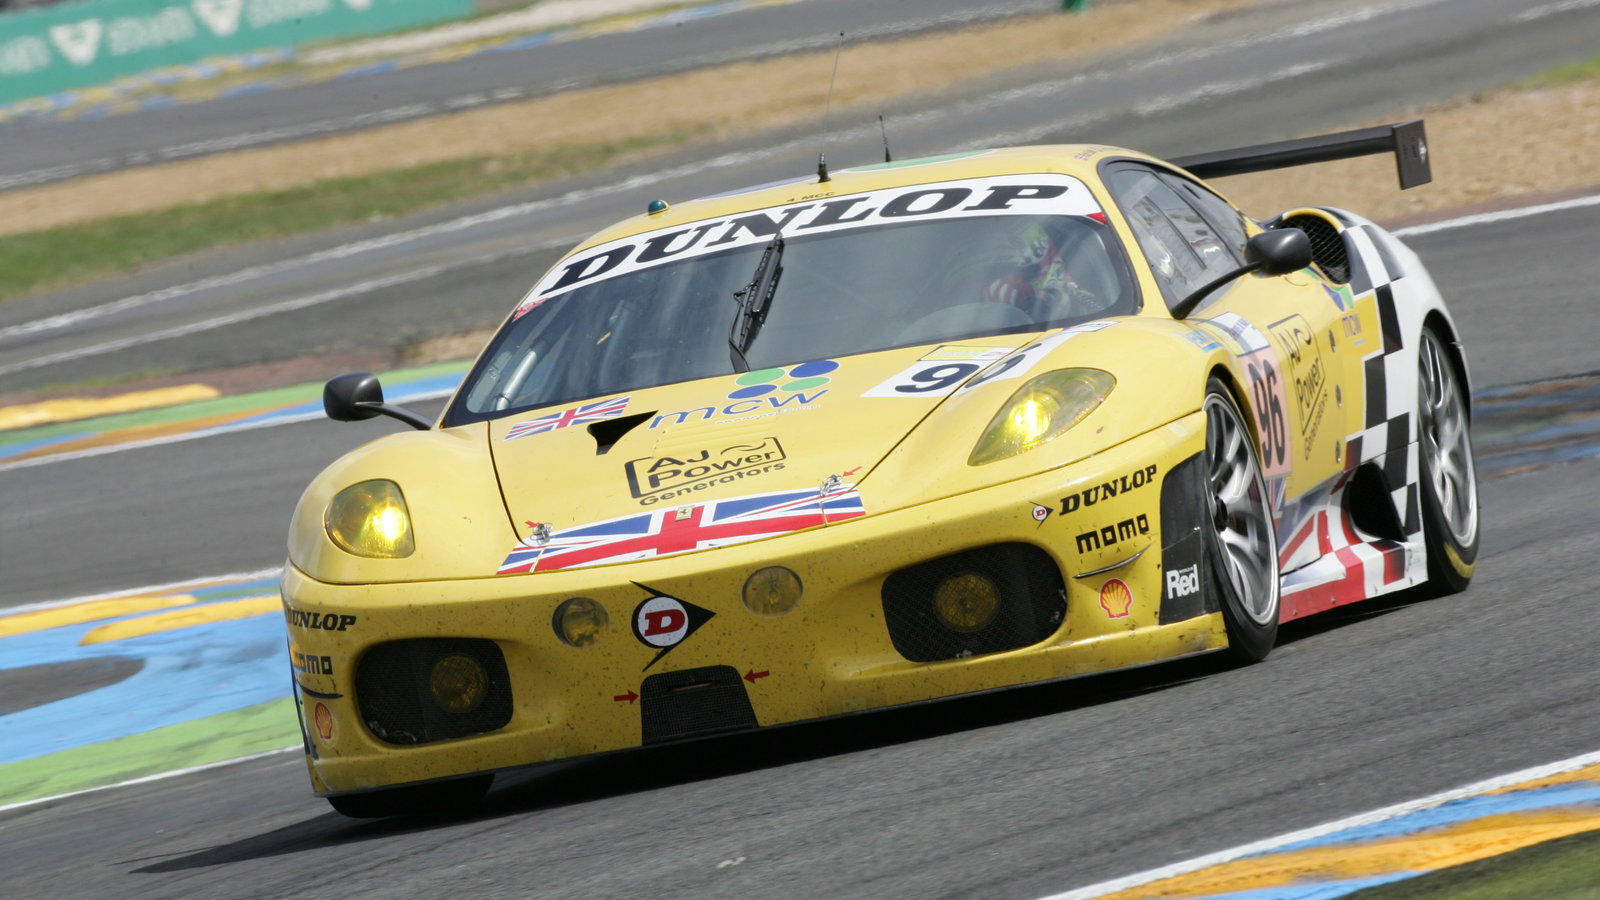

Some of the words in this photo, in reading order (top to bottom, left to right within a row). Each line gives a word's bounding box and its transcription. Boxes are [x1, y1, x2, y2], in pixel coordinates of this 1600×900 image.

[539, 185, 1068, 296] DUNLOP
[649, 389, 829, 430] mcw
[1296, 357, 1321, 423] Power
[1247, 359, 1286, 469] 96
[647, 450, 710, 473] AJ
[648, 451, 776, 489] Power
[639, 461, 786, 506] Generators
[1059, 464, 1157, 516] DUNLOP
[1075, 513, 1150, 554] momo
[1166, 563, 1200, 600] Red
[286, 607, 357, 632] DUNLOP
